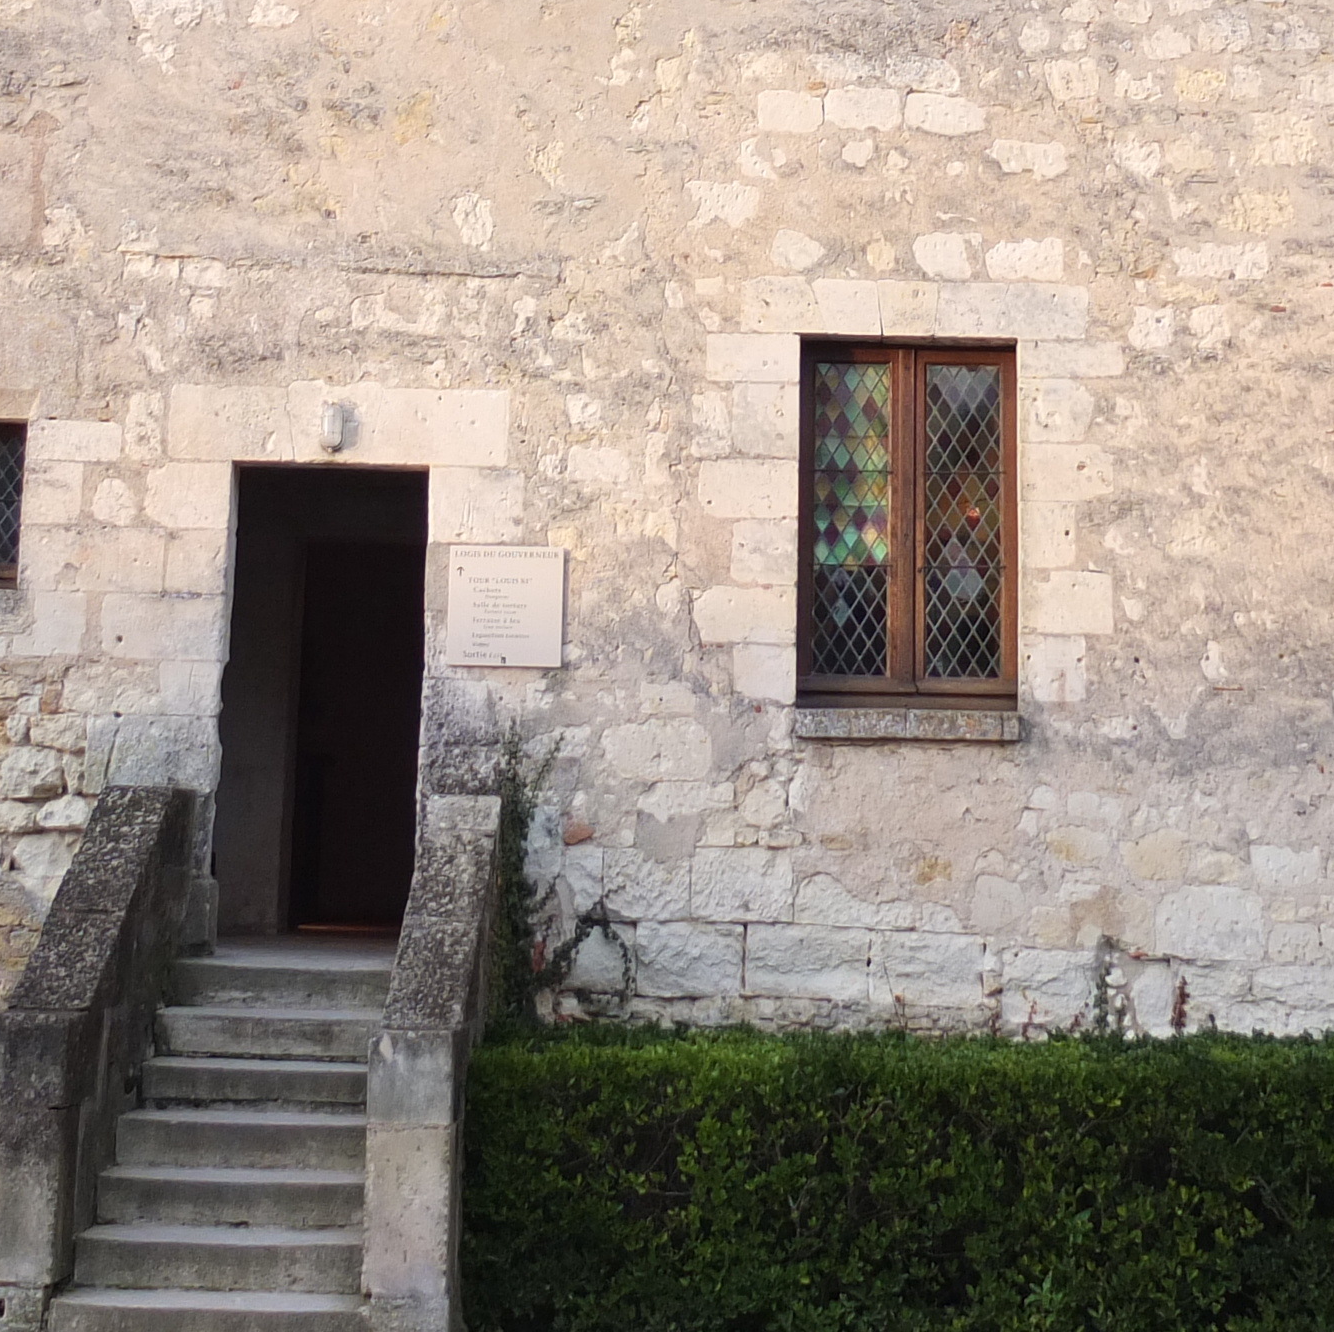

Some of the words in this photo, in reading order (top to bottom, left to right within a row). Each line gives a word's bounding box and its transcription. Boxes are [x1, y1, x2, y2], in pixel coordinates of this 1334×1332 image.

[454, 550, 481, 558] LOGIS
[483, 550, 496, 558] DU
[498, 550, 559, 559] GOUVERNEUR
[468, 576, 490, 584] TOUR
[463, 650, 487, 658] Sortie
